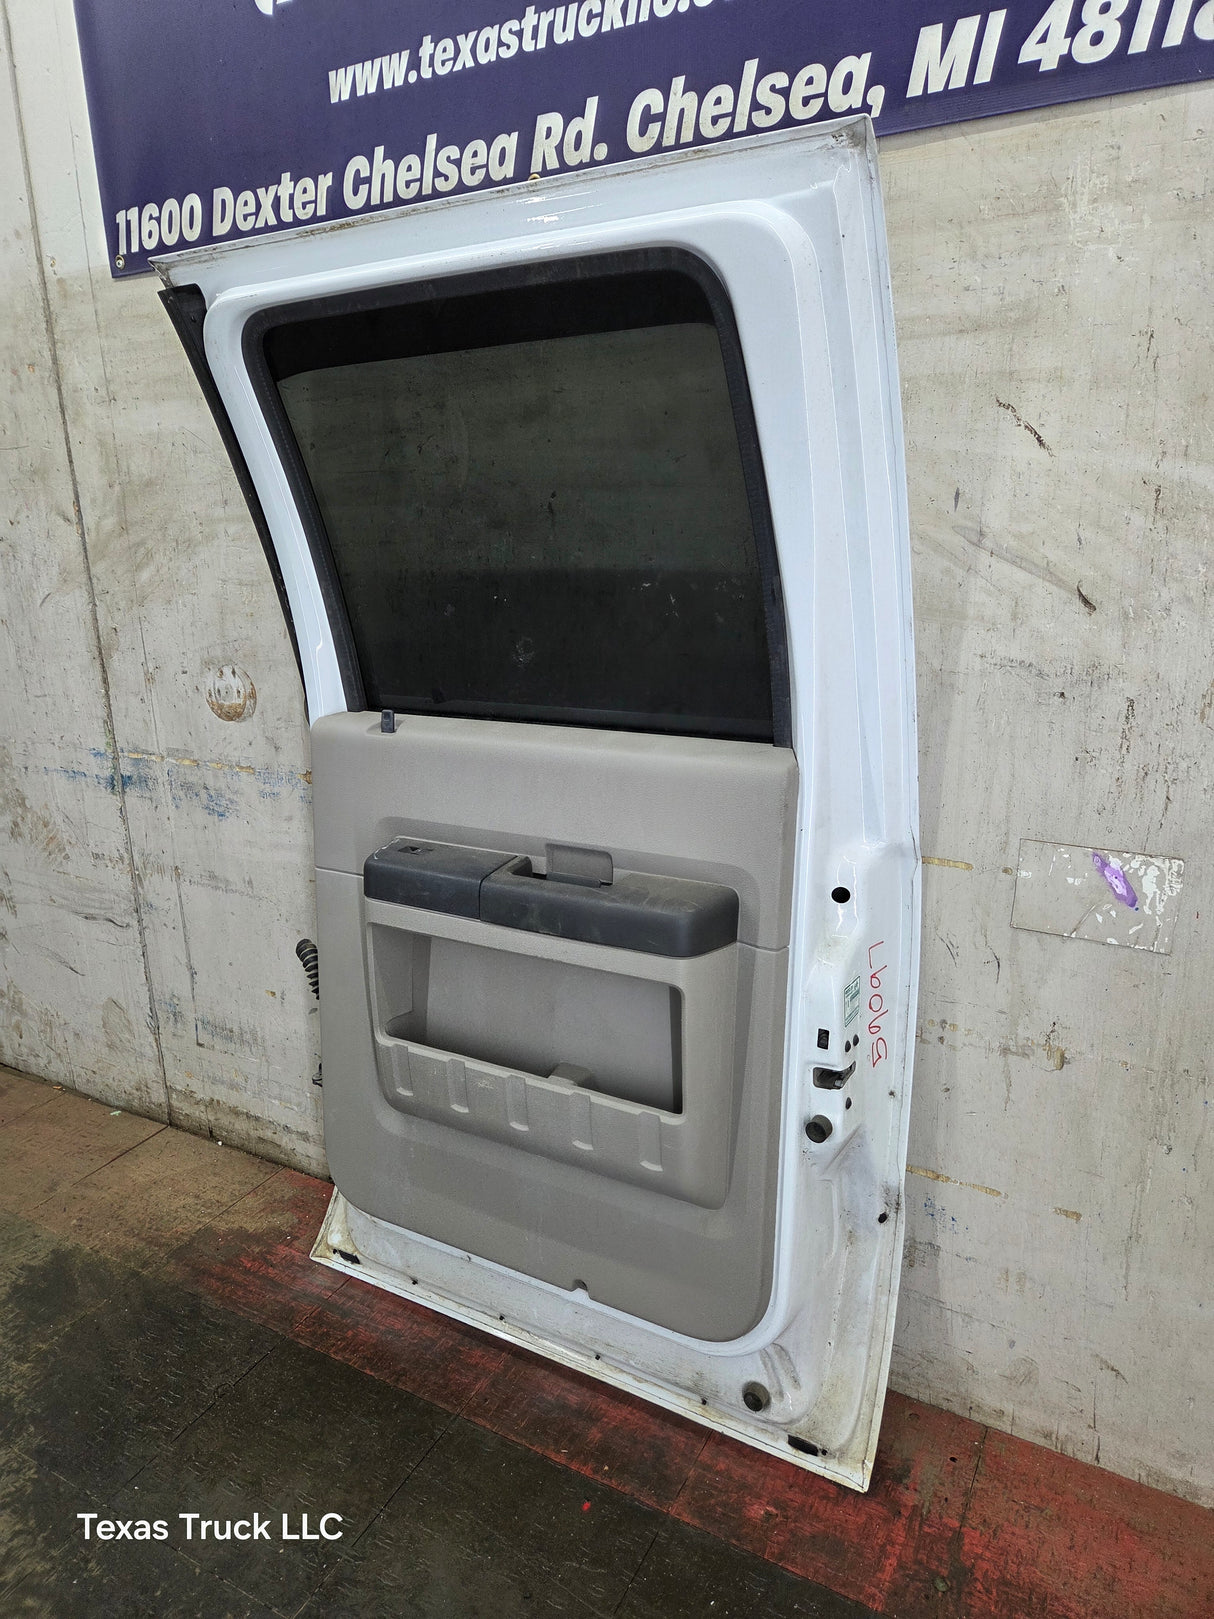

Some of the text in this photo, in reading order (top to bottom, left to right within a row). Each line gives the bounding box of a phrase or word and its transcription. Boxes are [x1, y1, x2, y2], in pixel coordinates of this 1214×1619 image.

[115, 0, 1214, 255] 11600 Dexter Chelsea Rd. Chelsea, MI 4811
